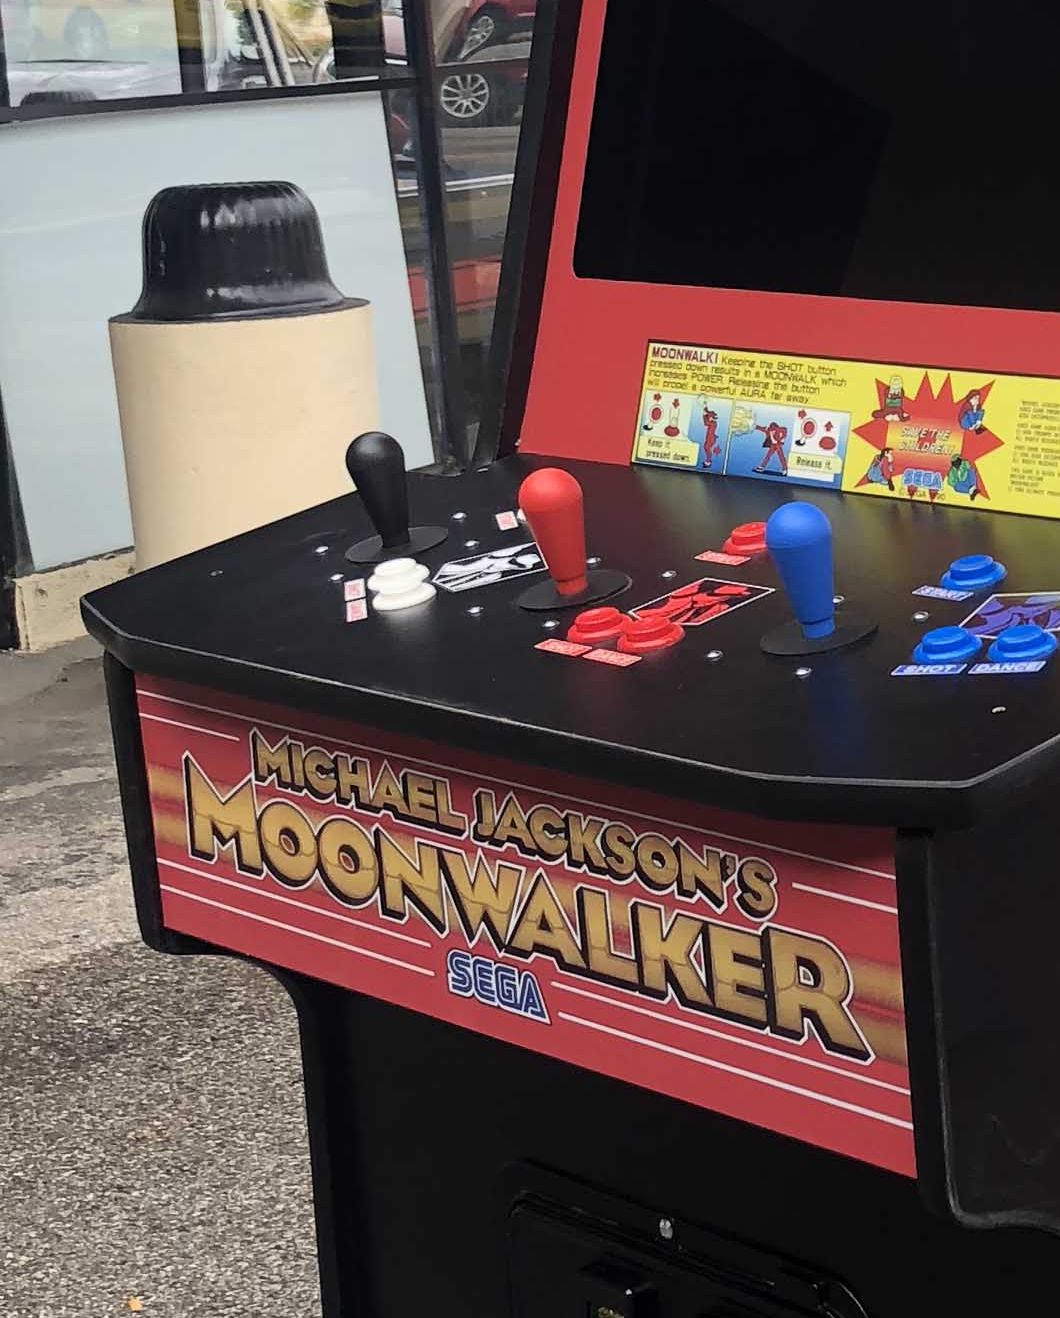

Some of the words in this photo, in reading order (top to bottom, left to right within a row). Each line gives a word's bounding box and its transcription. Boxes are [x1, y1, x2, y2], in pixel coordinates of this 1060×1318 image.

[652, 346, 718, 364] MOONWALK!
[721, 356, 755, 368] Keeping
[759, 360, 774, 369] the
[777, 361, 804, 371] SHOT
[807, 364, 836, 375] button
[648, 370, 687, 380] increases
[729, 377, 769, 390] Releasing
[773, 382, 788, 391] the
[792, 384, 820, 394] button
[650, 360, 682, 370] pressed
[686, 363, 709, 373] down
[711, 366, 740, 376] results
[744, 368, 751, 377] in
[764, 370, 817, 384] MOONWALK
[821, 377, 847, 387] which
[662, 380, 688, 390] propel
[700, 384, 736, 396] powerful
[740, 388, 766, 399] AURA
[771, 392, 783, 400] far
[648, 440, 664, 449] Keep
[929, 428, 951, 441] THE
[645, 450, 671, 460] pressed
[796, 456, 822, 469] Release
[902, 468, 943, 490] SEGA
[905, 665, 958, 673] SHOT
[977, 662, 1038, 672] DANCE
[249, 728, 471, 836] MICHAEL
[473, 786, 778, 920] JACKSON'S
[183, 751, 876, 1064] MOONWALKER
[447, 950, 552, 1025] SEGA
